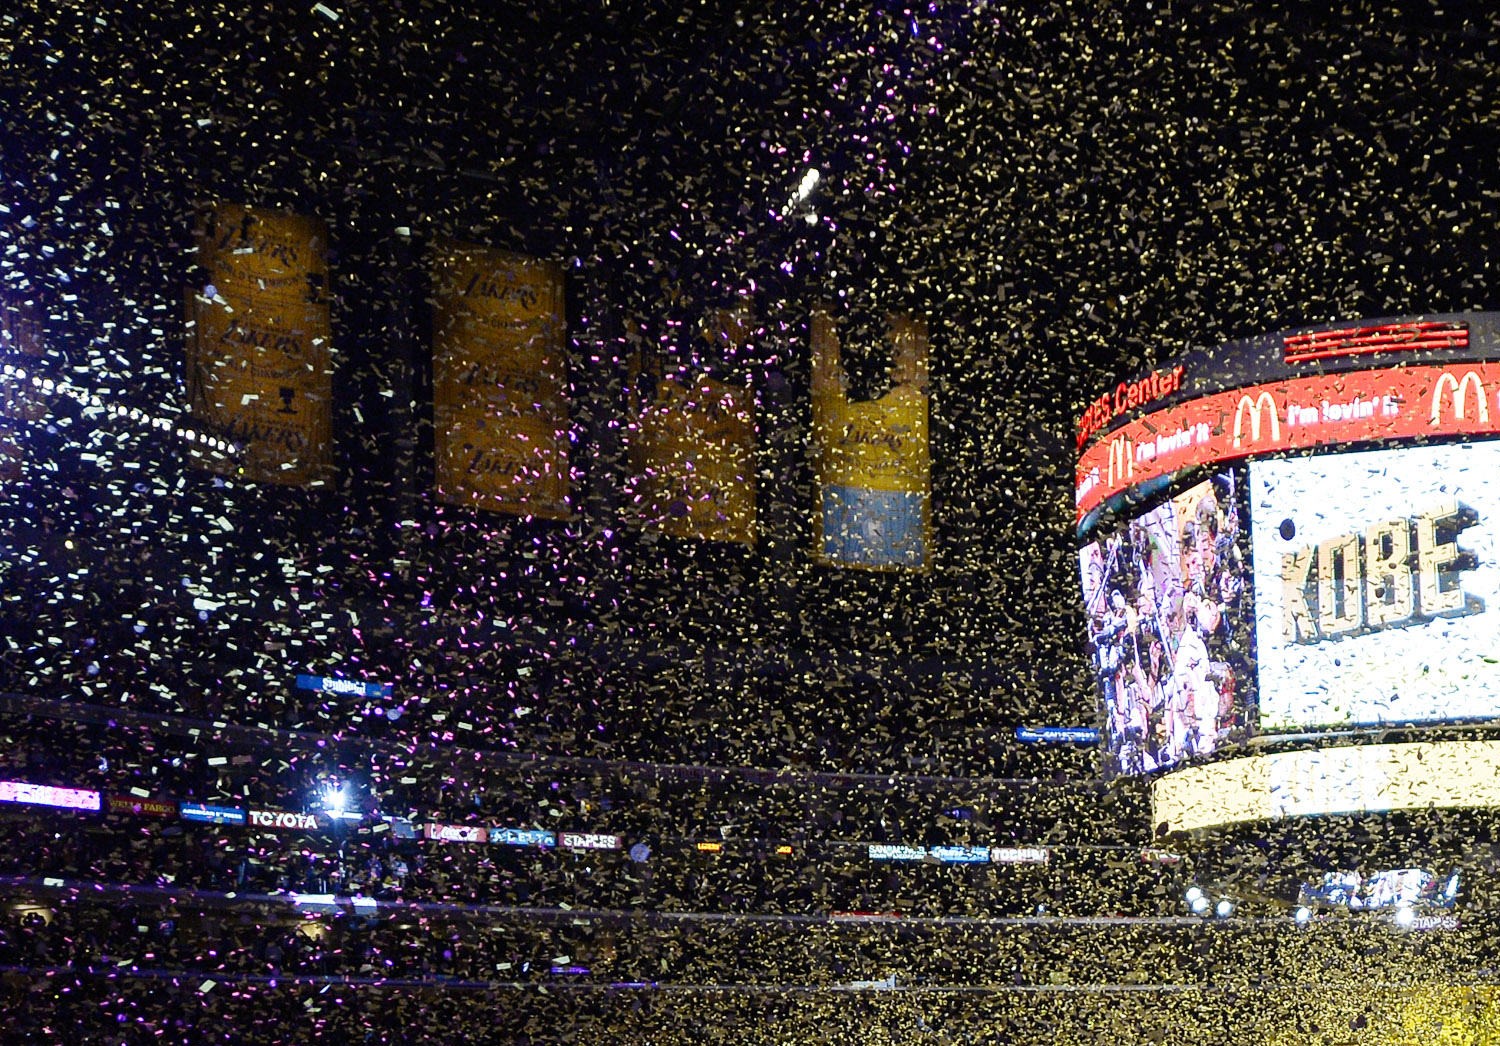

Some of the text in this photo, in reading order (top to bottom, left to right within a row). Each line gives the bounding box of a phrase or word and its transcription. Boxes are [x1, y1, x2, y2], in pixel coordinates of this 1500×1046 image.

[1115, 365, 1183, 414] Center
[1282, 500, 1468, 642] KOBE
[143, 802, 176, 814] FARGO
[249, 811, 318, 829] TOYOTA
[563, 833, 616, 848] STAPLES
